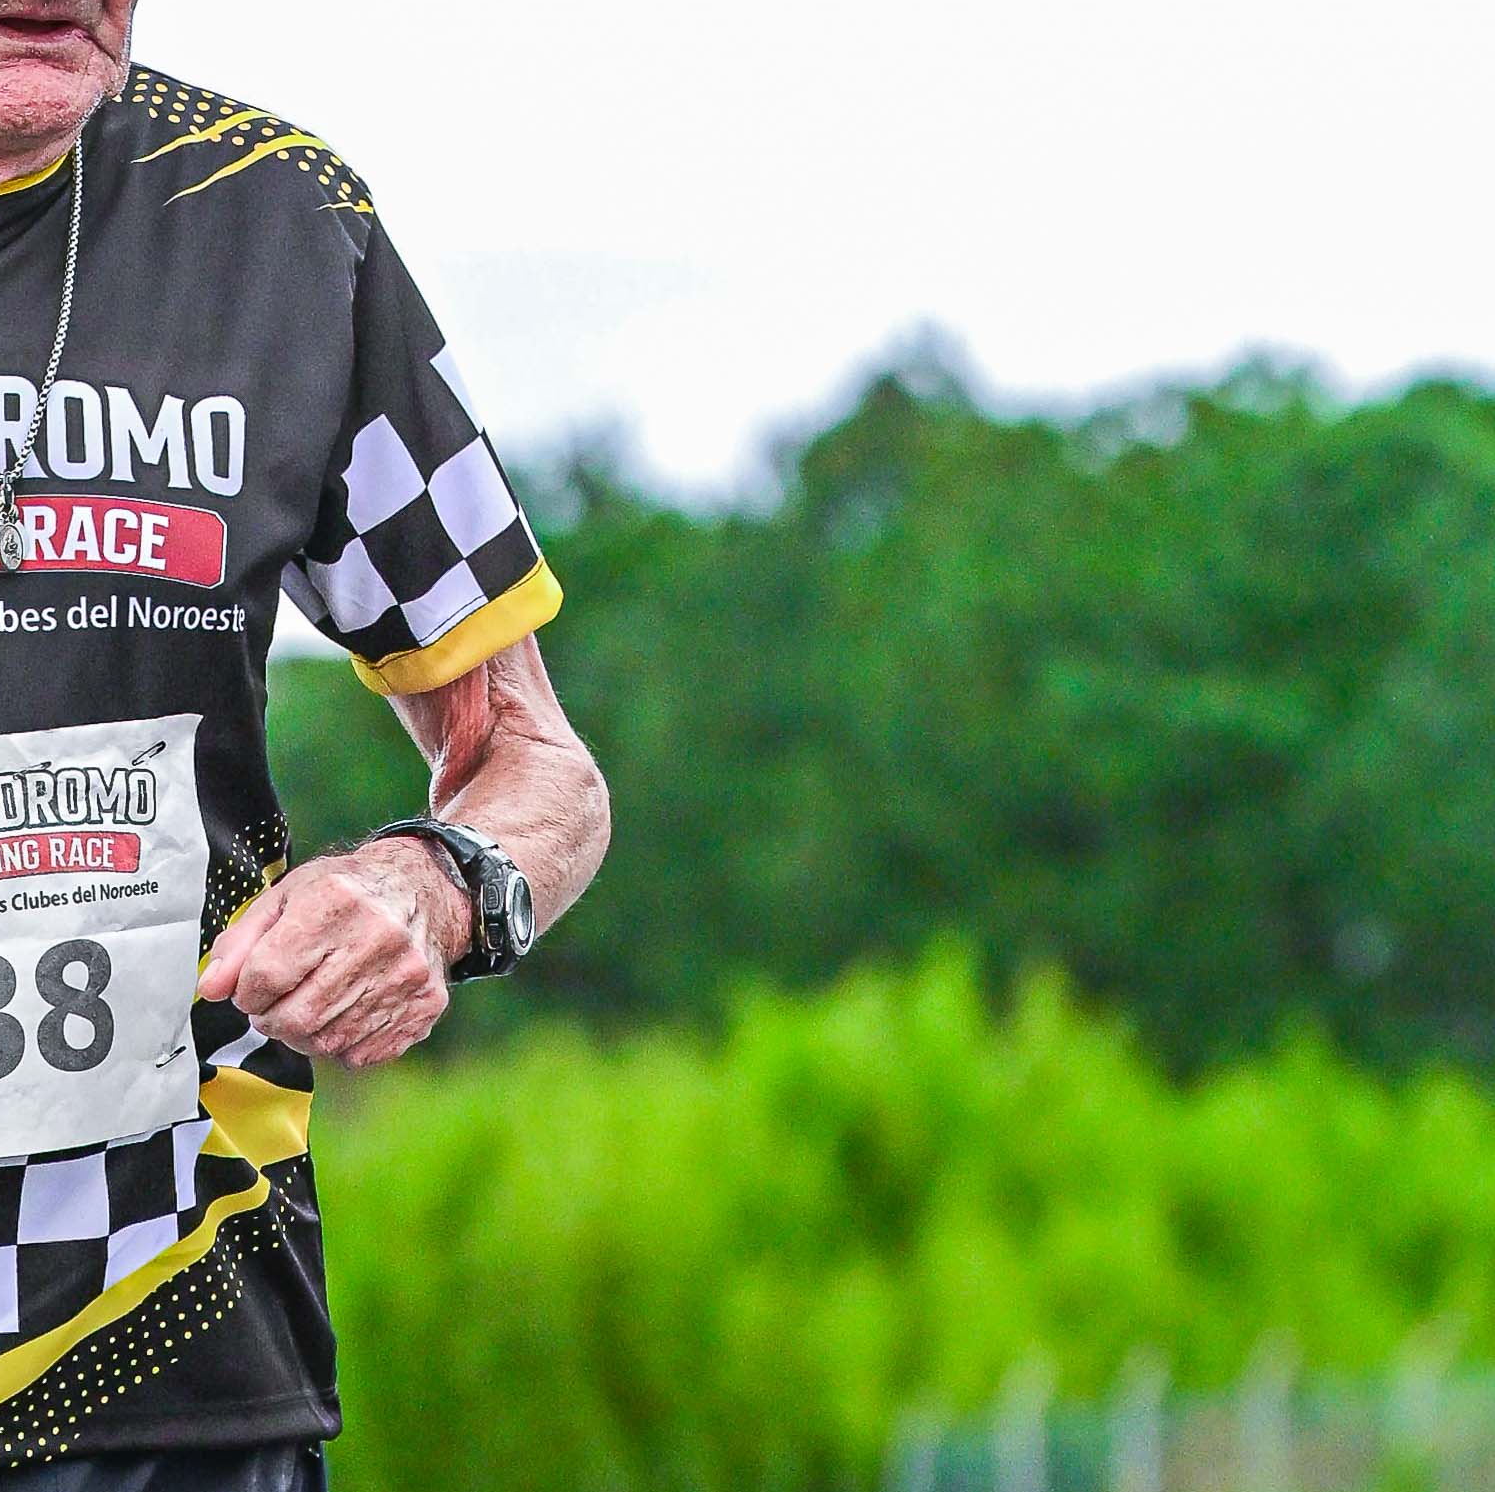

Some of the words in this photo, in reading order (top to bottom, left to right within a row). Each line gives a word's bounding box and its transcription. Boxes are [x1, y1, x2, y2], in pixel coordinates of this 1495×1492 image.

[21, 504, 170, 570] RACE
[66, 594, 117, 629] del
[127, 595, 246, 633] Noroeste
[49, 835, 115, 871] RACE
[11, 890, 69, 911] Clubes
[72, 883, 96, 904] del
[100, 878, 159, 901] Noroeste
